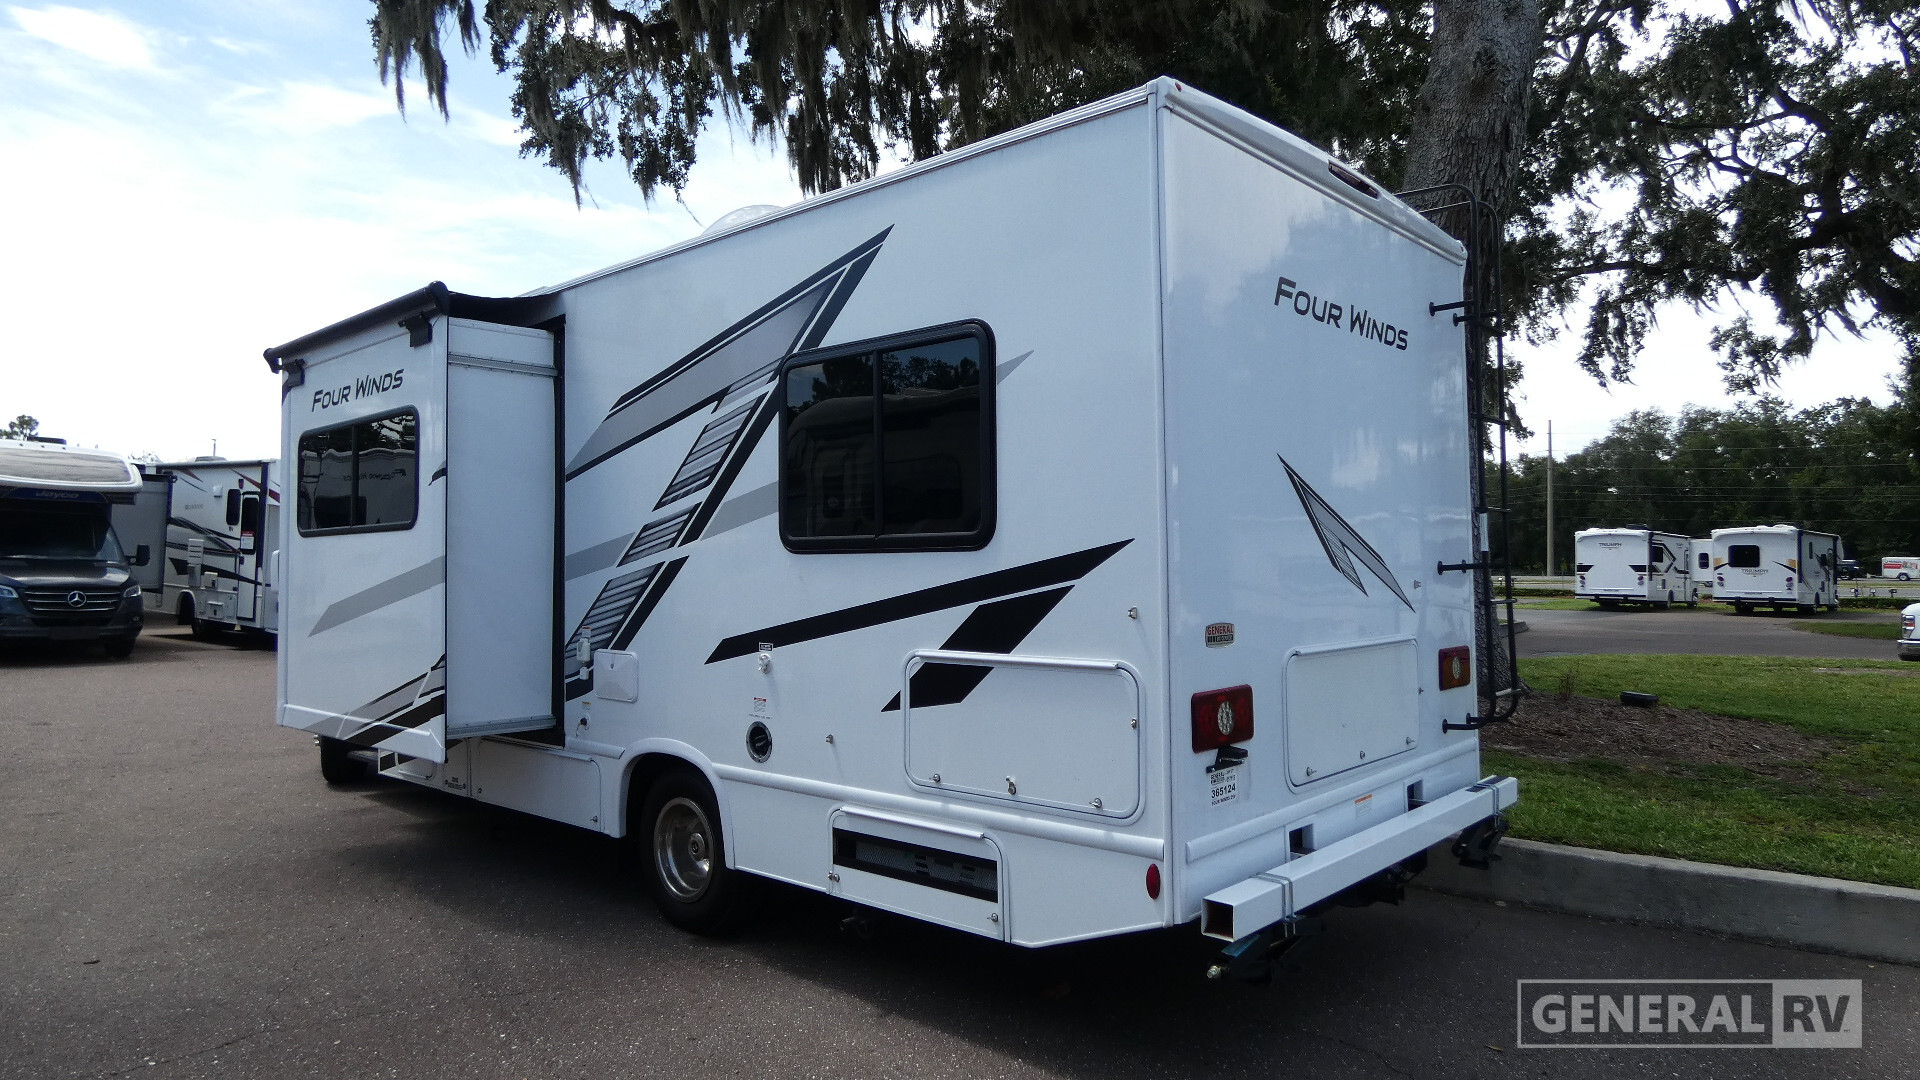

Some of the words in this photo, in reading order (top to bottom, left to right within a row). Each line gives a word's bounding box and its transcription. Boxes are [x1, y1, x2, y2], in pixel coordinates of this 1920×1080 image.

[1273, 276, 1343, 329] FOUR
[1349, 304, 1409, 351] WINDS
[311, 385, 351, 412] FOUR
[355, 368, 405, 400] WINDS
[1207, 625, 1234, 636] GENERAL
[1211, 783, 1236, 799] 365124
